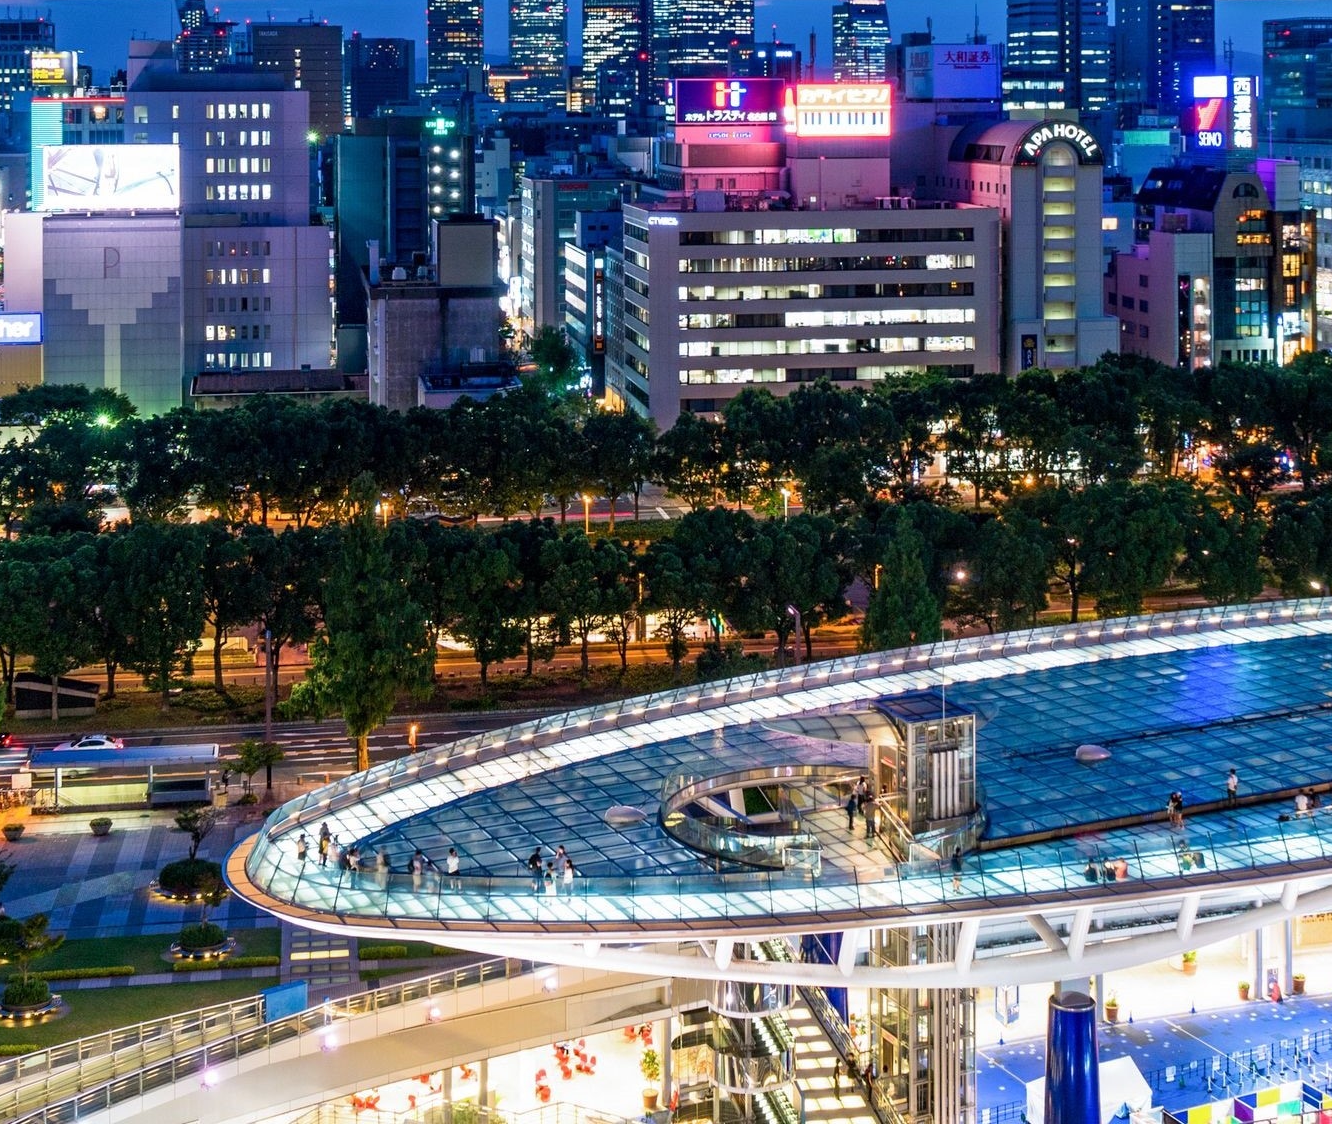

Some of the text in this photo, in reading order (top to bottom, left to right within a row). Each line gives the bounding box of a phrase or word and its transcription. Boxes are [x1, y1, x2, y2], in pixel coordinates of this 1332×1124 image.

[944, 50, 992, 63] 大和証券
[800, 88, 889, 104] カワイピアノ
[706, 110, 746, 122] トラスティ
[1024, 123, 1098, 157] APA HOTEL
[1198, 131, 1222, 147] SEINO
